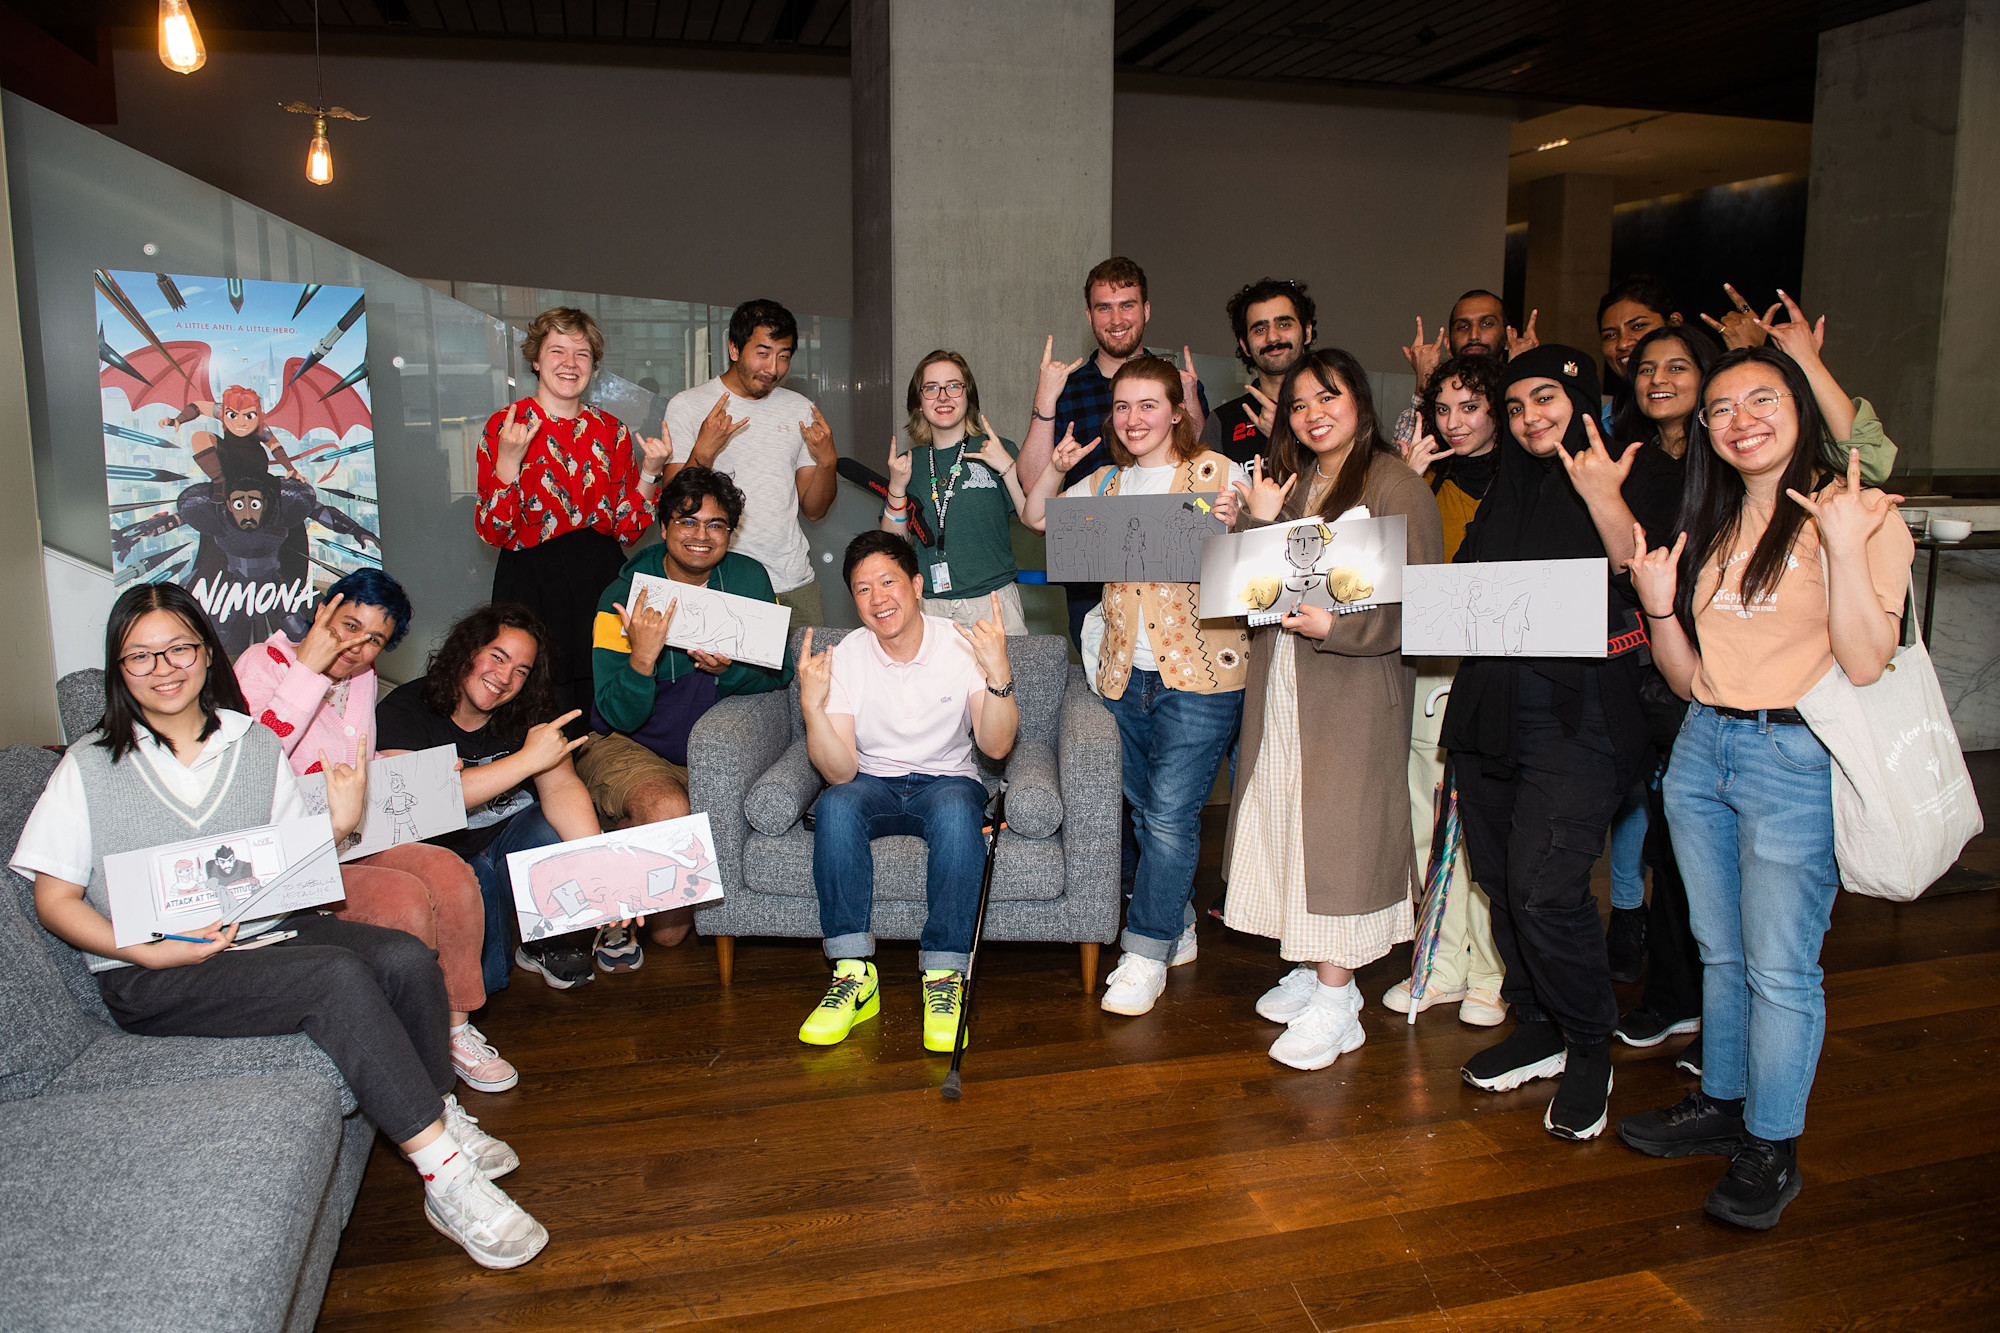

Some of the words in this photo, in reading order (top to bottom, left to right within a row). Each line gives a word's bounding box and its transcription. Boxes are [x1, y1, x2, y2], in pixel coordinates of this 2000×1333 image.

[184, 322, 209, 330] LITTLE
[246, 325, 270, 333] LITTLE
[273, 327, 298, 335] HERO.
[191, 570, 320, 623] NIMONA
[1712, 588, 1747, 604] Happ
[166, 897, 194, 909] ATTACK
[195, 894, 204, 903] AT
[205, 891, 219, 901] THE
